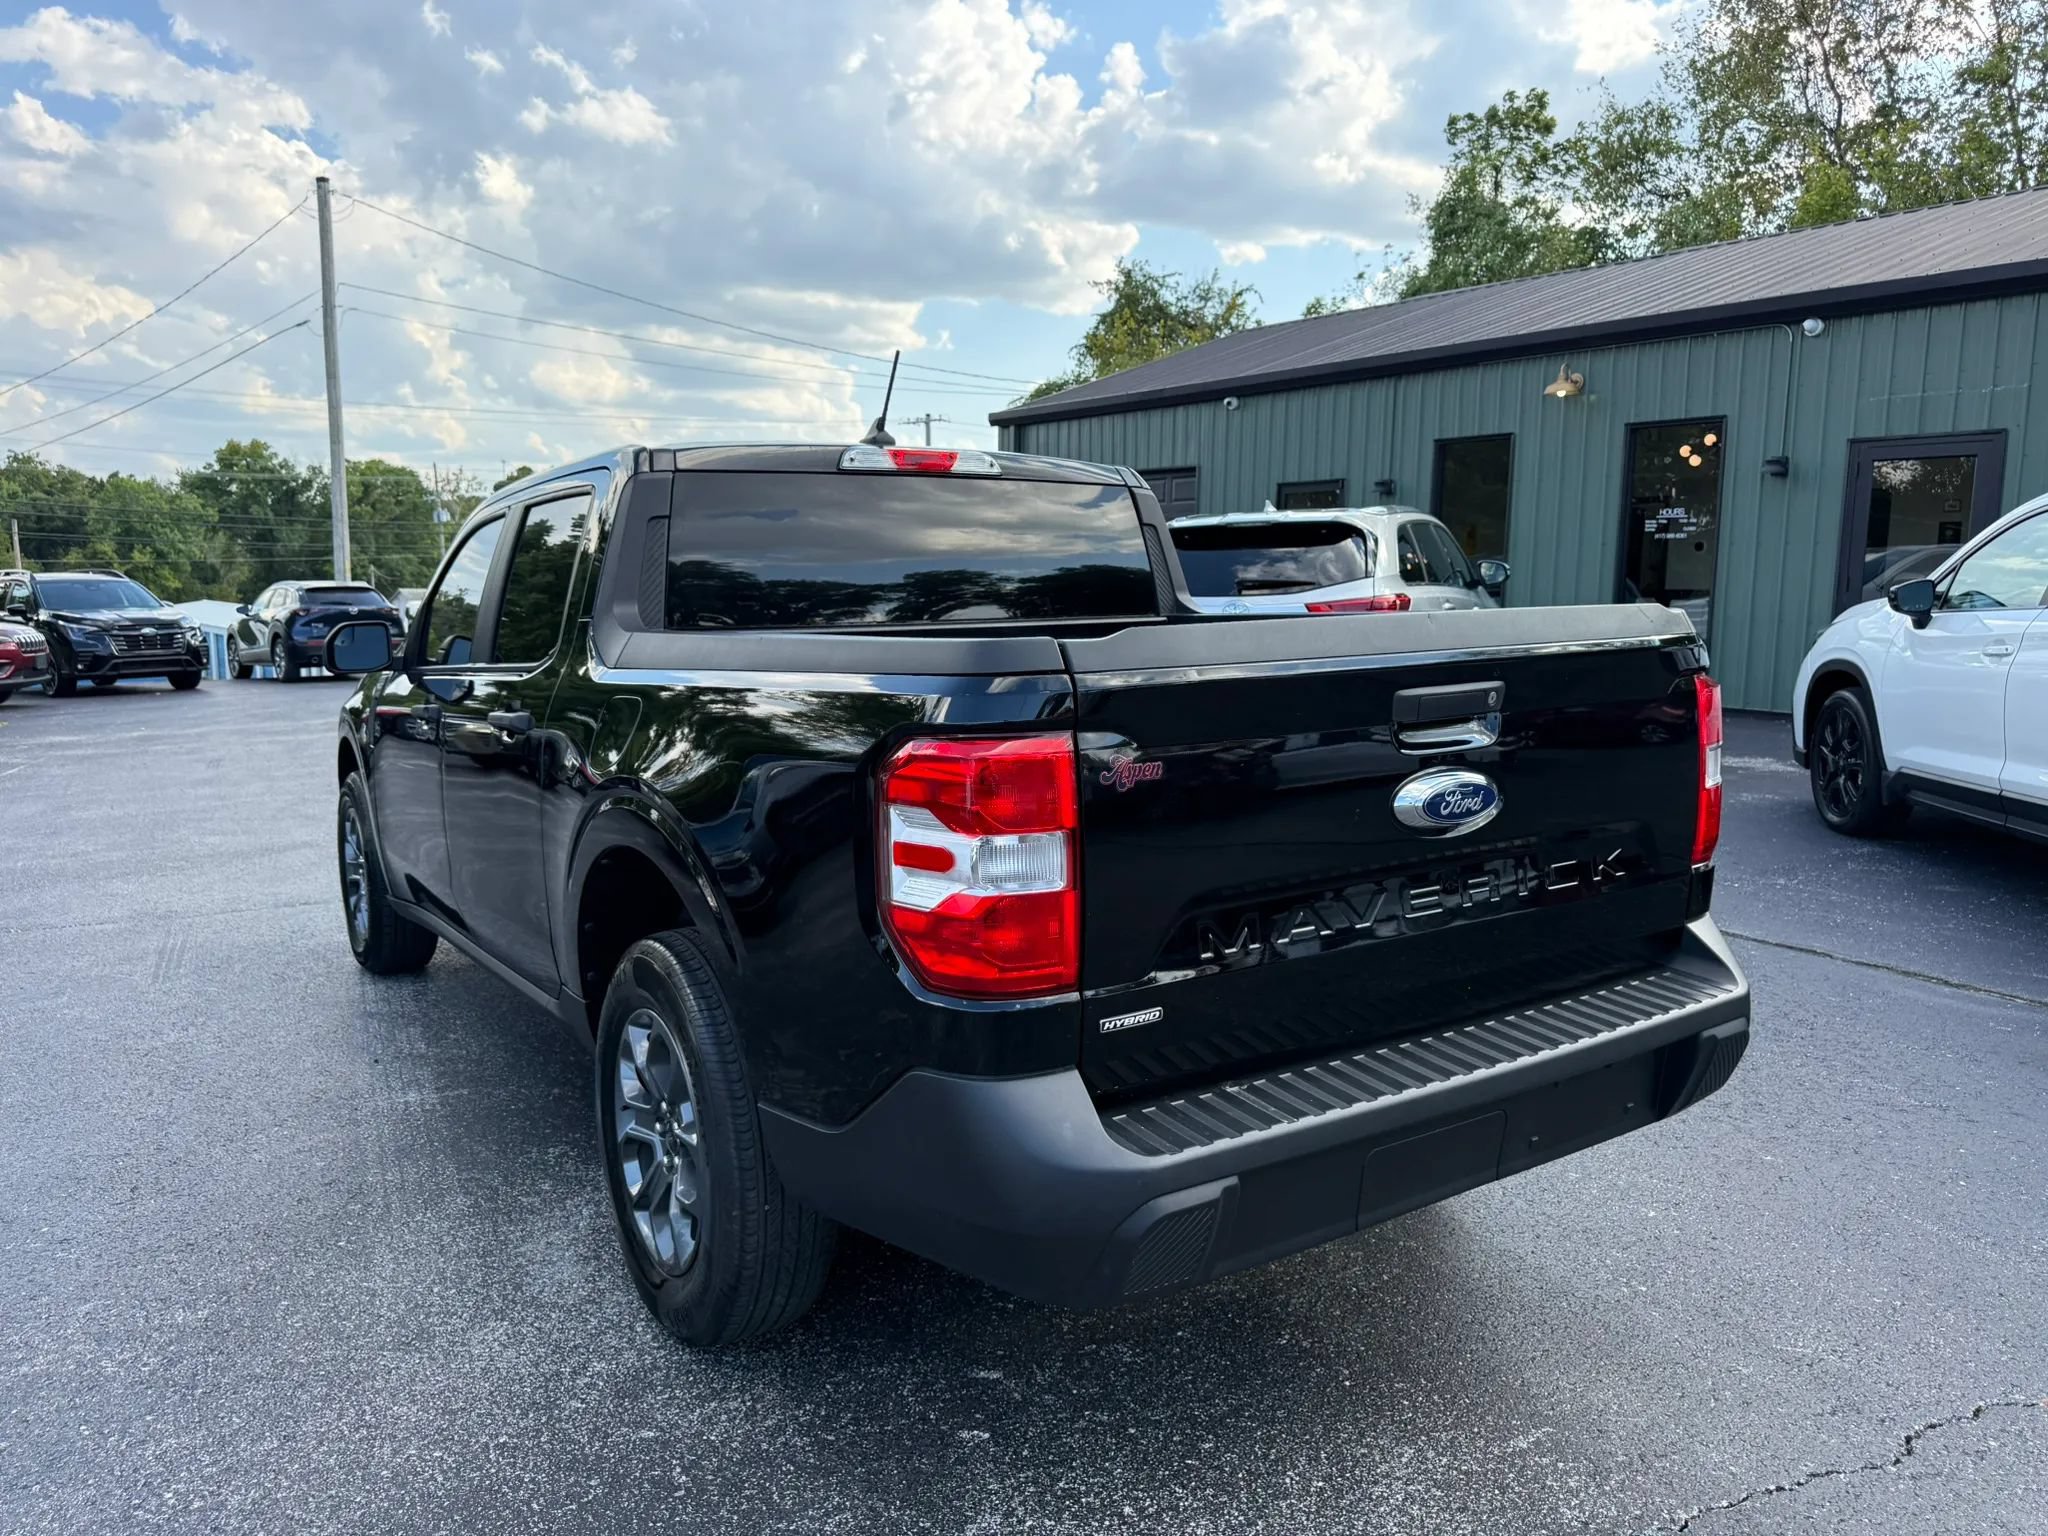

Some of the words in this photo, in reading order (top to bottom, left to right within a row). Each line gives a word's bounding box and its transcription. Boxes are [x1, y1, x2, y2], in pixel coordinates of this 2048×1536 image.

[1659, 507, 1685, 515] HOURS
[1100, 754, 1163, 792] Aspen
[1440, 786, 1484, 815] Ford
[1197, 848, 1626, 959] MAVERICK
[1103, 1011, 1160, 1030] HYBRID
